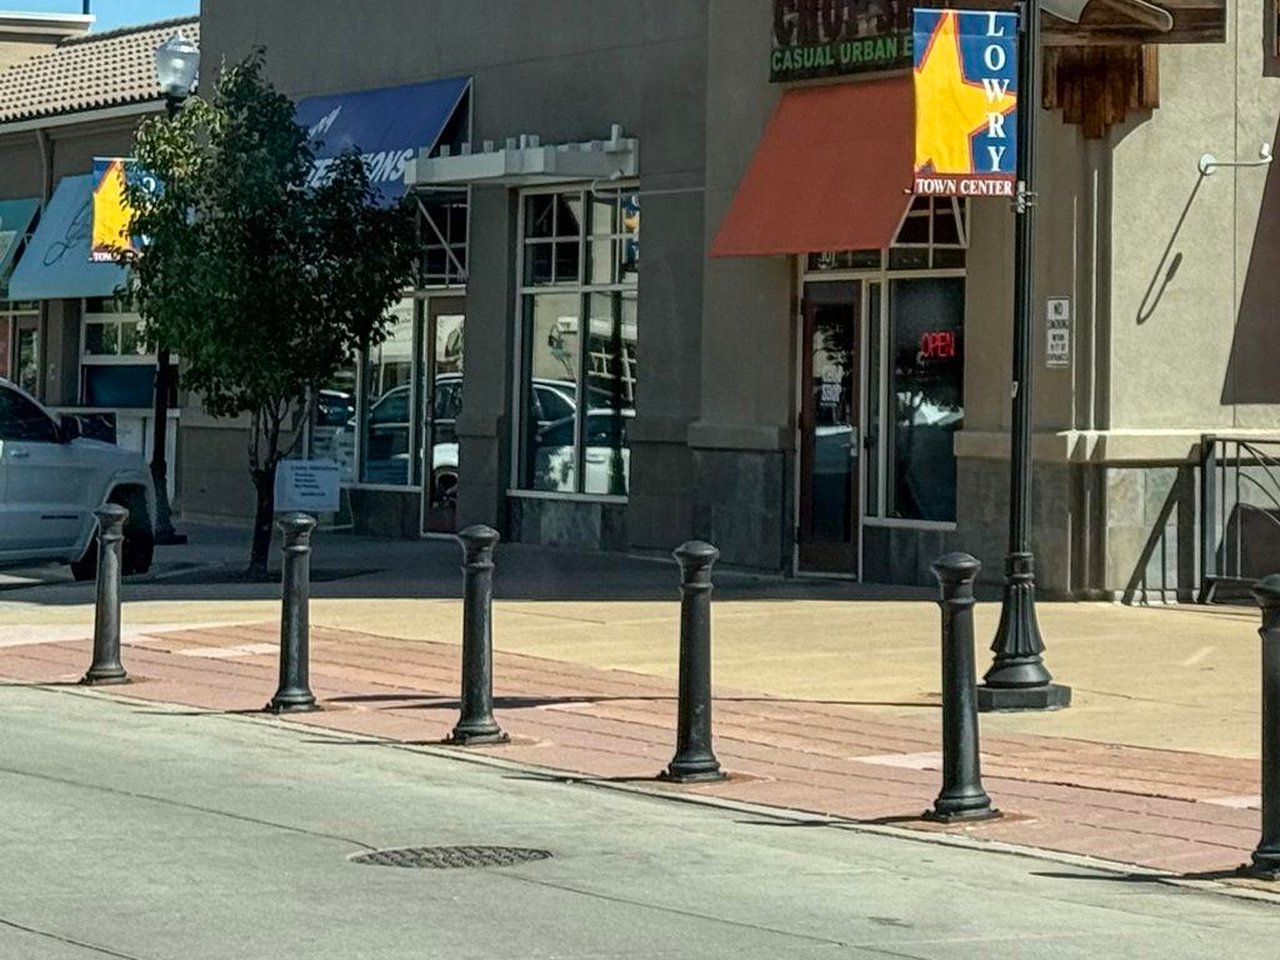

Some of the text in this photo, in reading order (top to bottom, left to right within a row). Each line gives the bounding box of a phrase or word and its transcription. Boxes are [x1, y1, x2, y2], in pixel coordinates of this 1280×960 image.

[771, 43, 834, 71] CASUAL
[840, 37, 897, 63] URBAN
[983, 11, 1010, 173] LOWRY
[917, 178, 1012, 195] TOWN CENTER
[921, 332, 955, 358] OPEN
